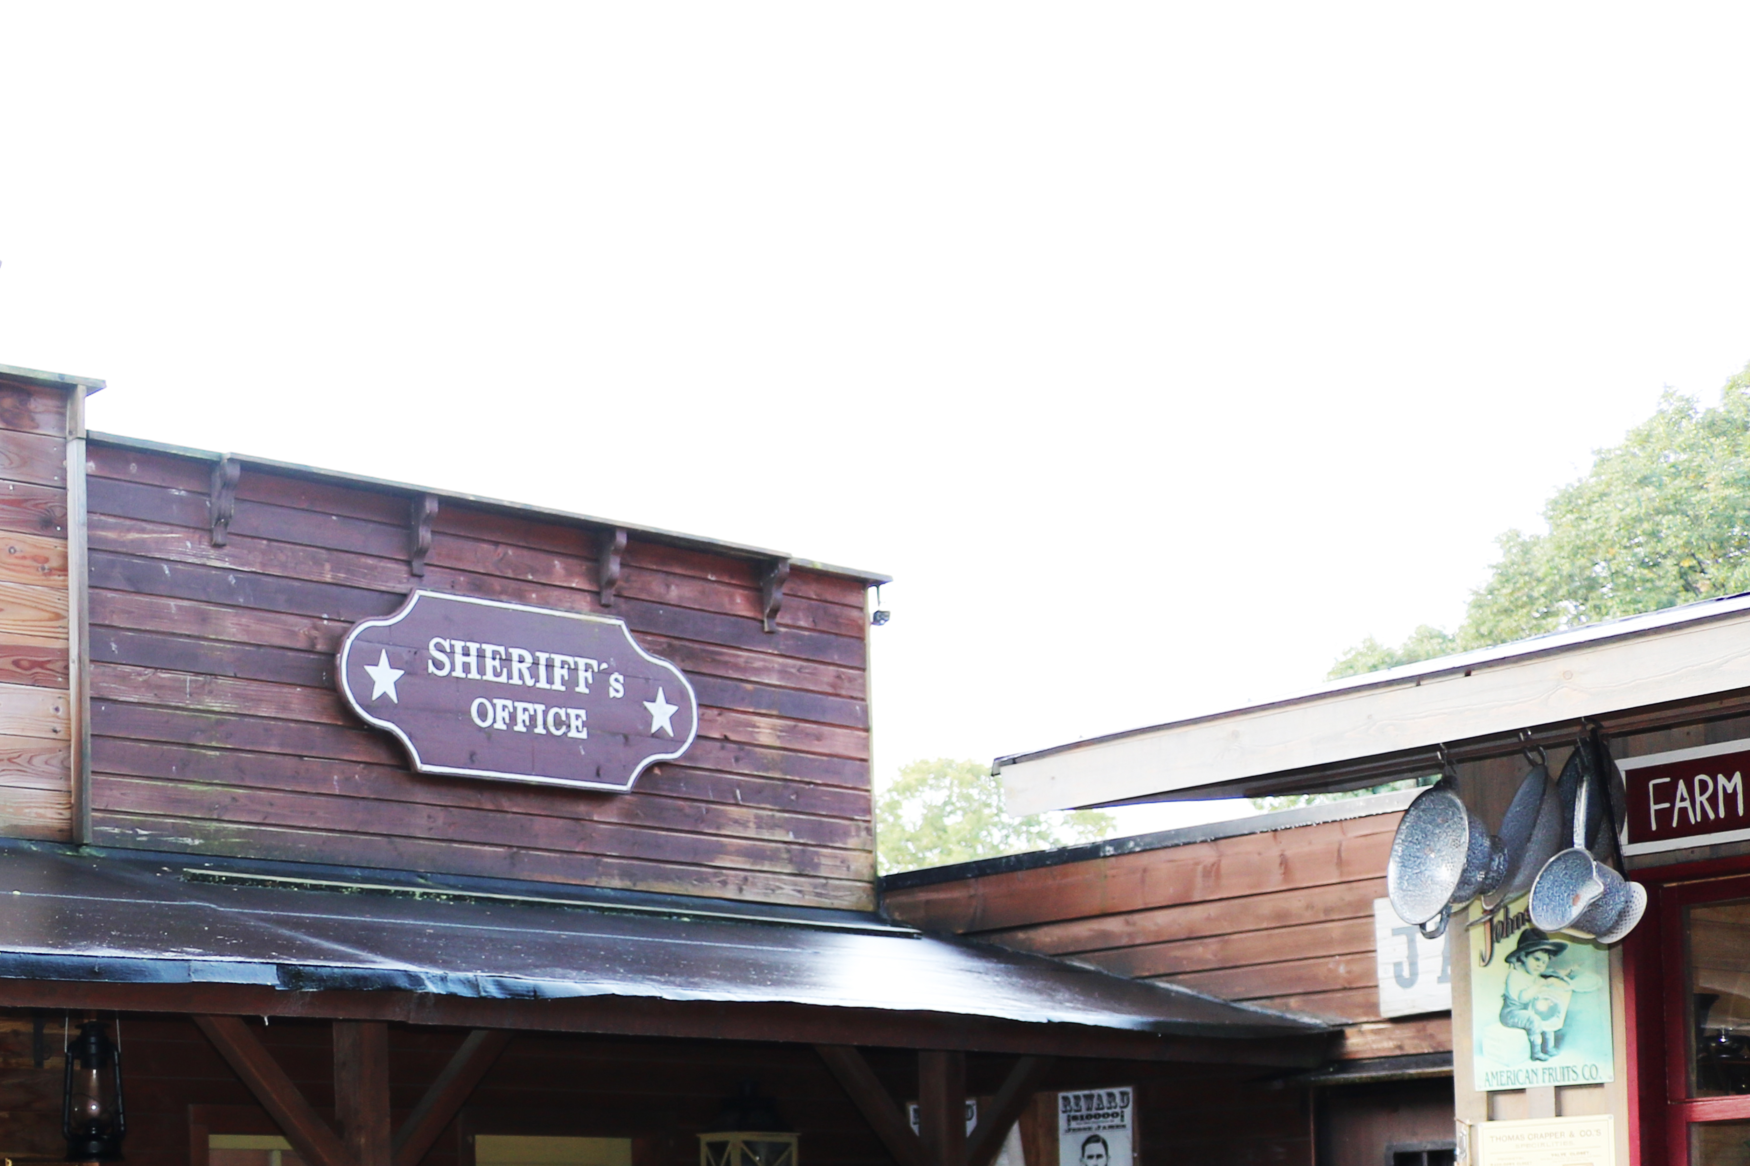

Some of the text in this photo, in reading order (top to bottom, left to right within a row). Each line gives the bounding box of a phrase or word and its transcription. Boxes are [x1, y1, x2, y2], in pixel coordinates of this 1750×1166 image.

[470, 697, 588, 740] OFFICE
[1648, 771, 1745, 831] FARM
[1484, 1068, 1538, 1088] AMERICAN
[1541, 1065, 1578, 1083] FRUITS
[1061, 1091, 1130, 1113] REWARD
[1490, 1133, 1525, 1143] THOMAS
[1527, 1131, 1566, 1141] CRAPPER
